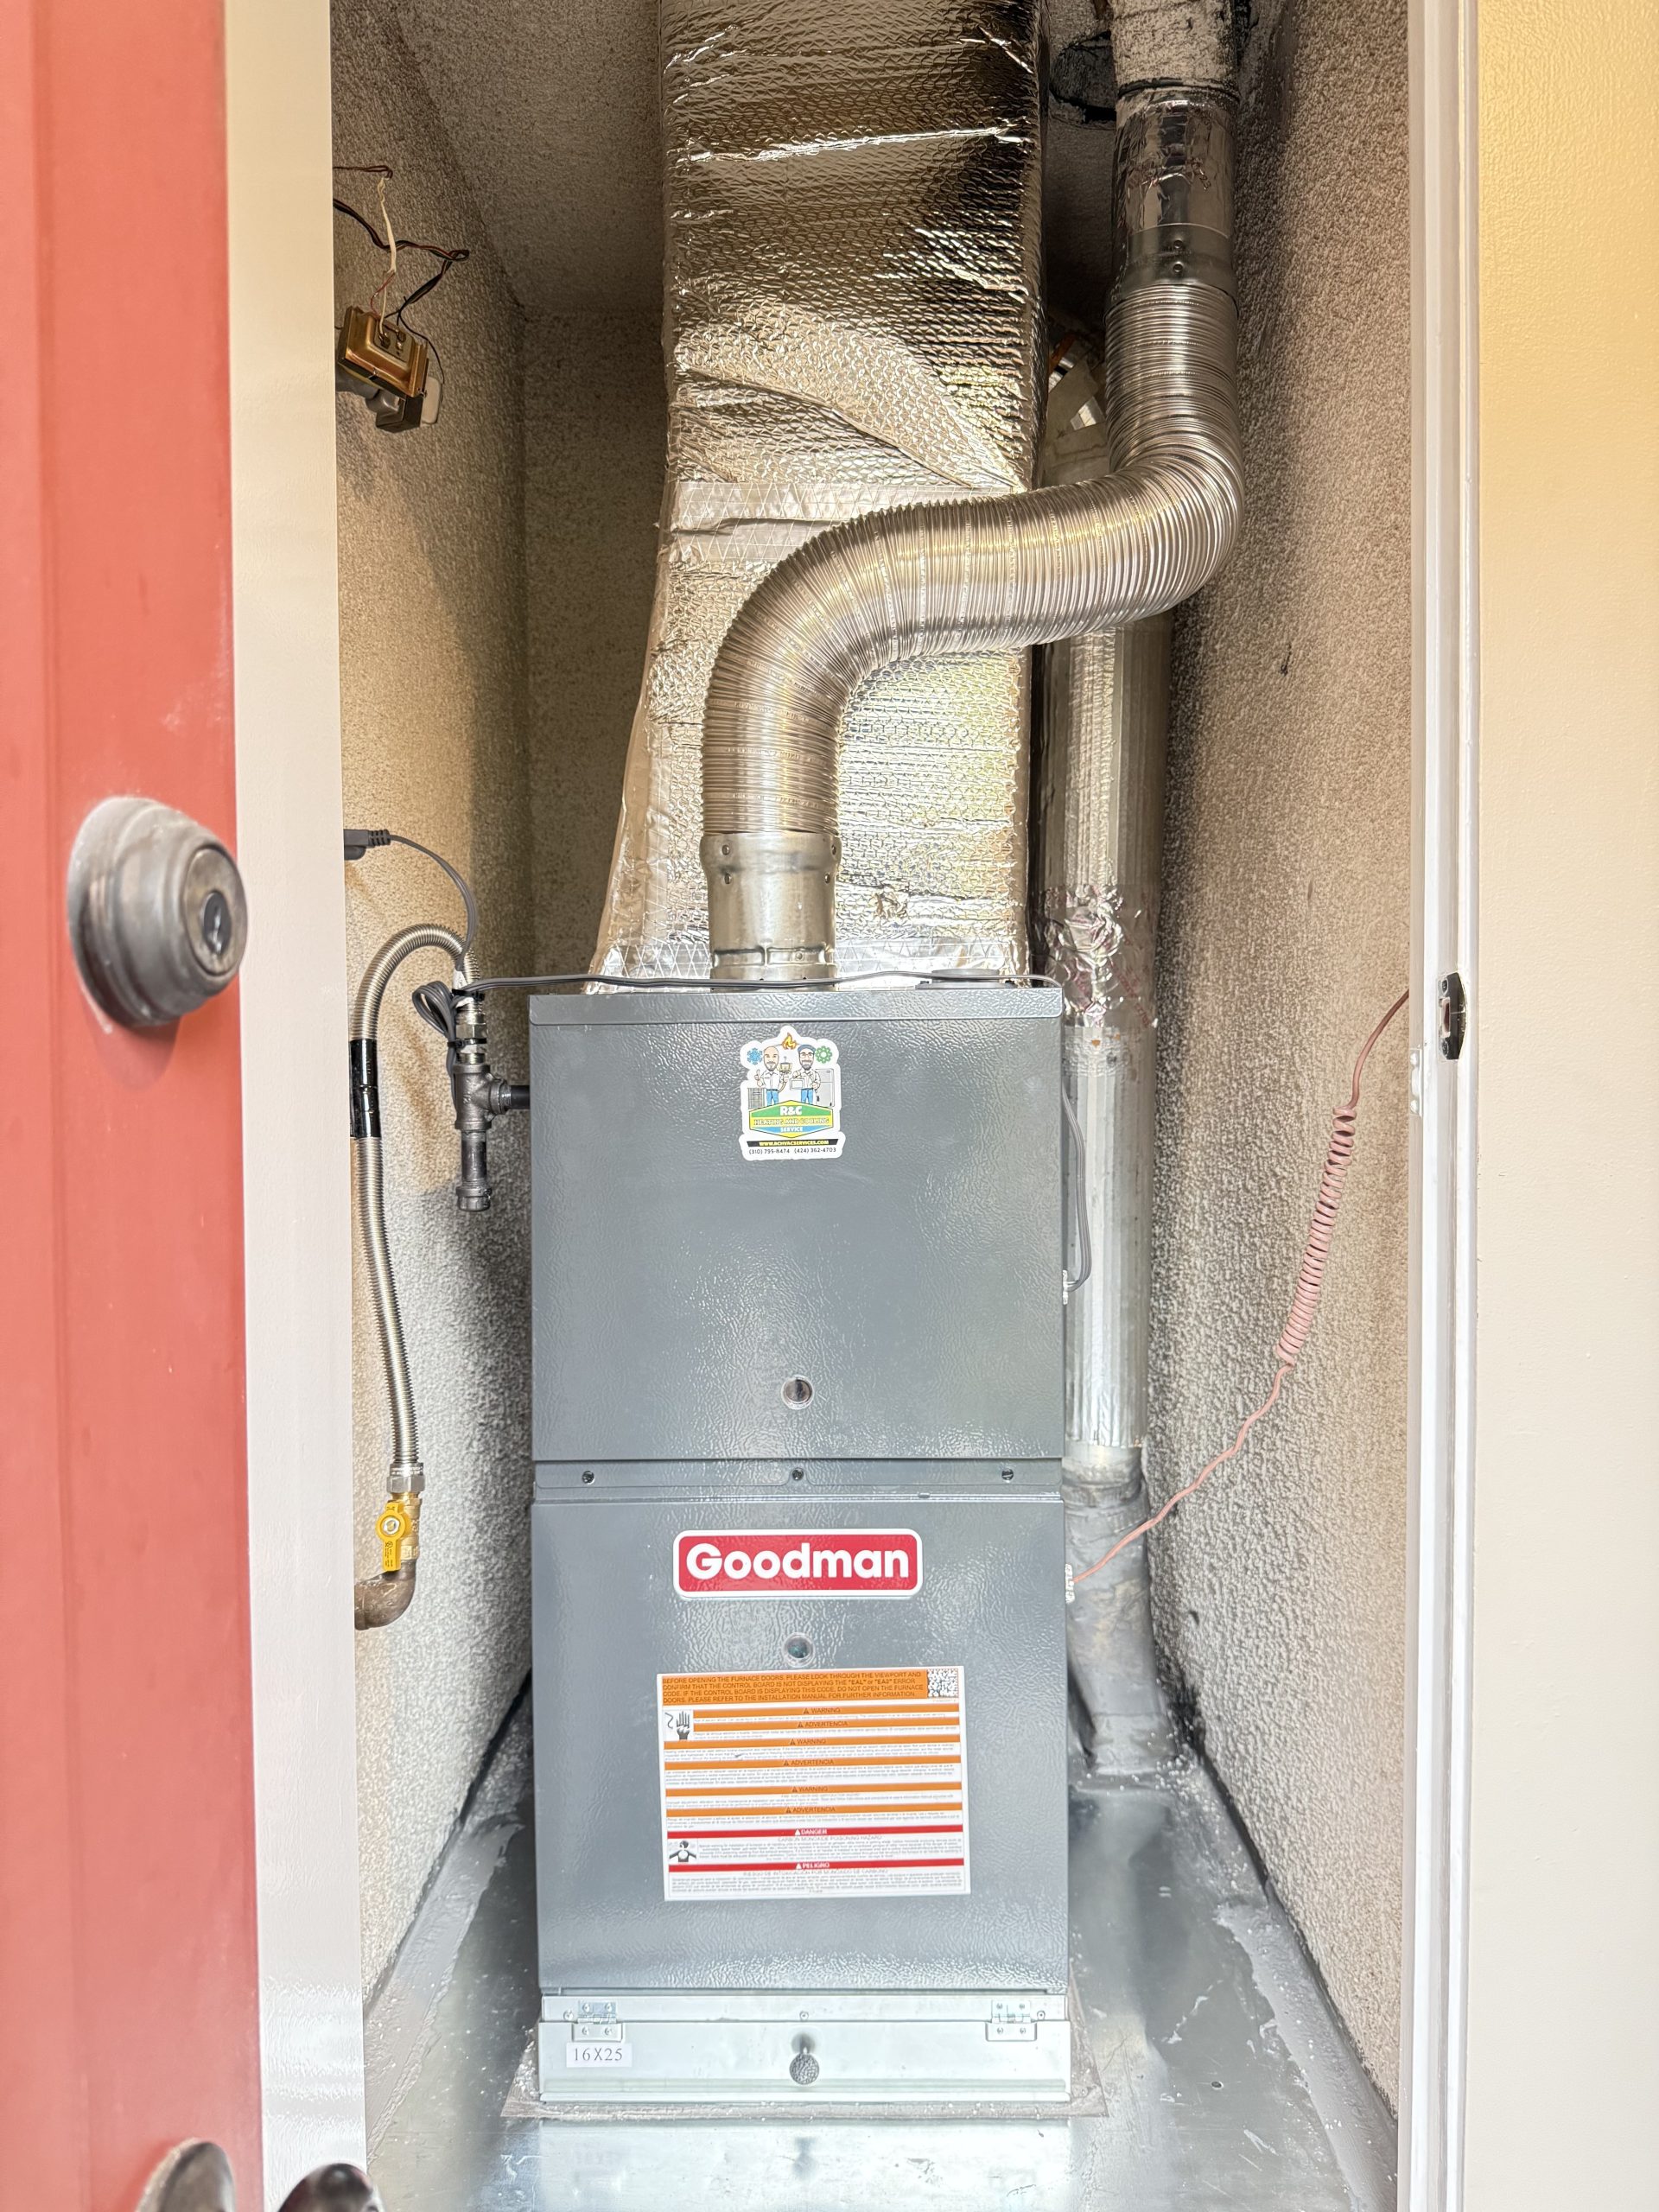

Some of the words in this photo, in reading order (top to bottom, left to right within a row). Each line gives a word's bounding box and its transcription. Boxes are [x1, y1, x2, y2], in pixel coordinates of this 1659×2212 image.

[779, 1106, 802, 1116] R&C
[686, 1542, 909, 1580] Goodman
[575, 2047, 623, 2062] 16X25
